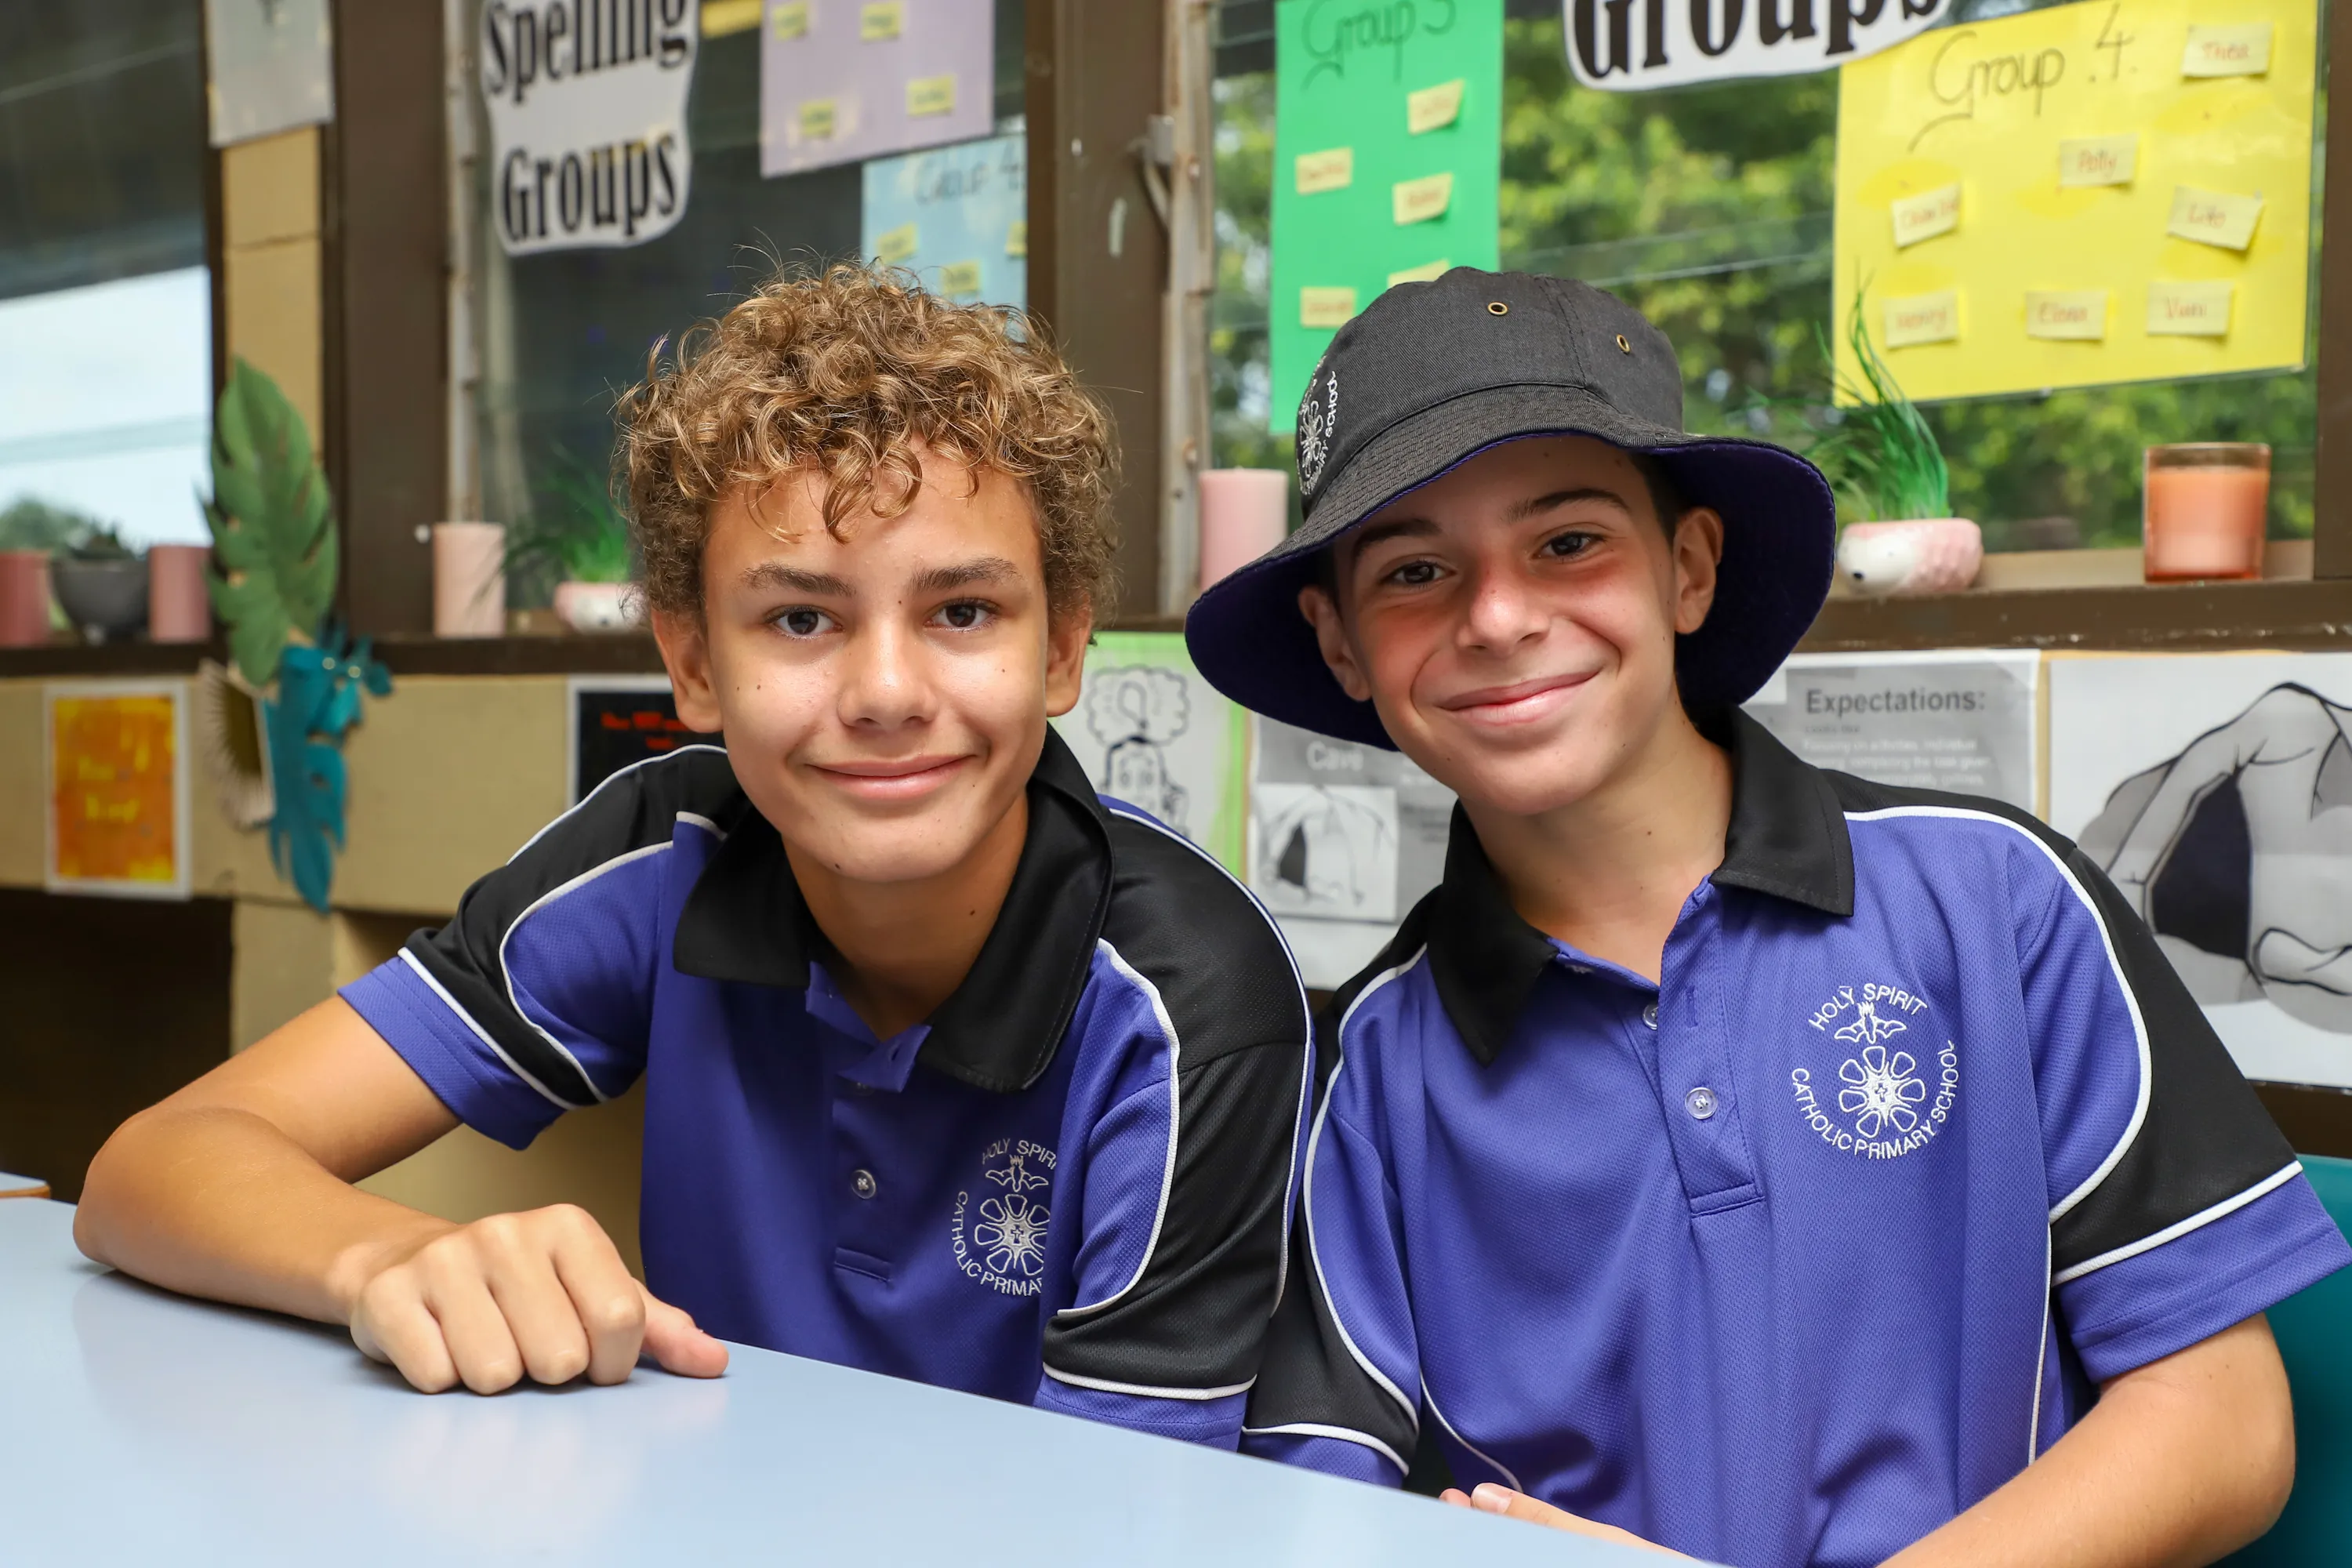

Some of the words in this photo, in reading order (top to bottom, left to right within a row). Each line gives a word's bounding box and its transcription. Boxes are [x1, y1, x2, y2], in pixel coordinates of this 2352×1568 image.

[487, 0, 688, 104] Spelling
[1573, 0, 1938, 79] Group
[1907, 29, 2066, 154] Group
[503, 132, 676, 243] Groups
[1325, 370, 1338, 437] SCHOOL
[1806, 686, 1985, 717] Expectations:
[1808, 985, 1855, 1031] HOLY
[1863, 982, 1928, 1015] SPIRIT
[1791, 1068, 1853, 1150] CATHOLIC
[1854, 1120, 1936, 1160] PRIMARY
[1930, 1040, 1959, 1123] SCHOOL
[982, 1138, 1011, 1165] HOLY
[1016, 1139, 1057, 1170] SPIR
[951, 1191, 982, 1277] CATHOLIC
[980, 1271, 1043, 1297] PRIMA
